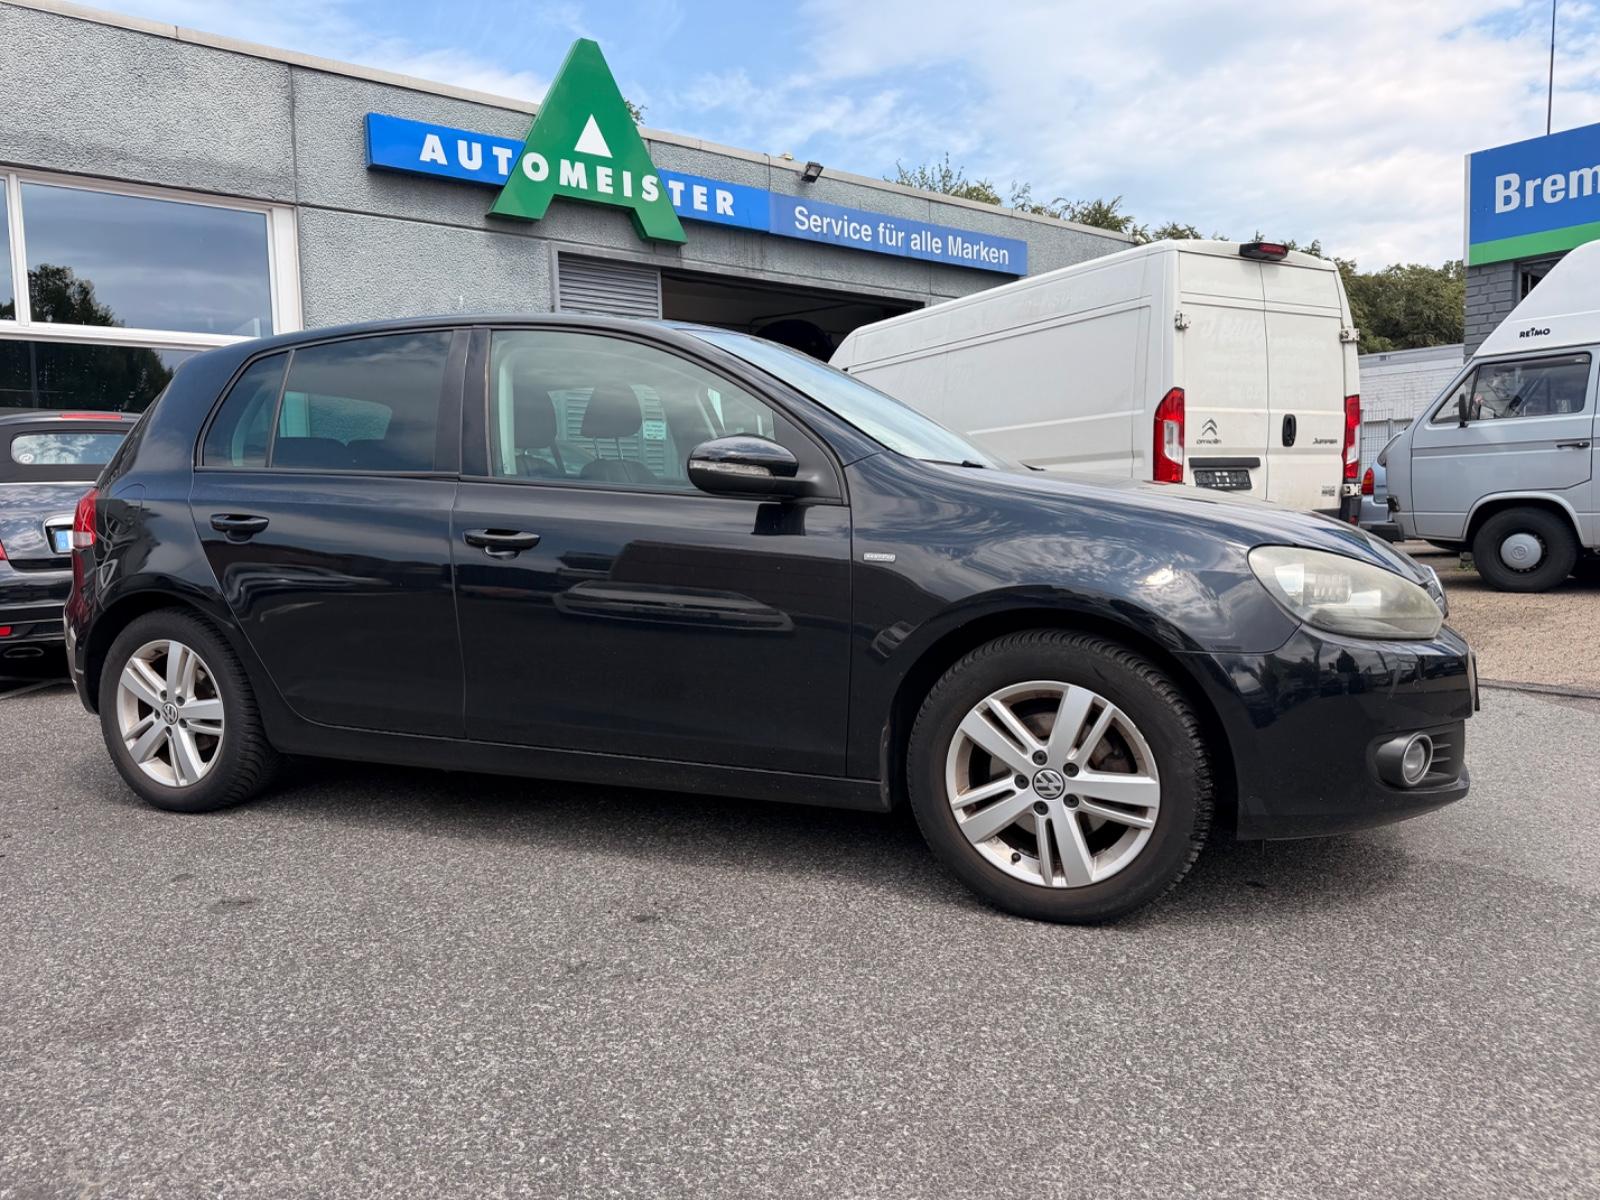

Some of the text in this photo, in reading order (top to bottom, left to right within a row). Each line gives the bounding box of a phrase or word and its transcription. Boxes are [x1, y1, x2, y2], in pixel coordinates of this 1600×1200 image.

[419, 133, 735, 217] AUTOMEISTER
[794, 205, 1009, 265] Service für alle Marken
